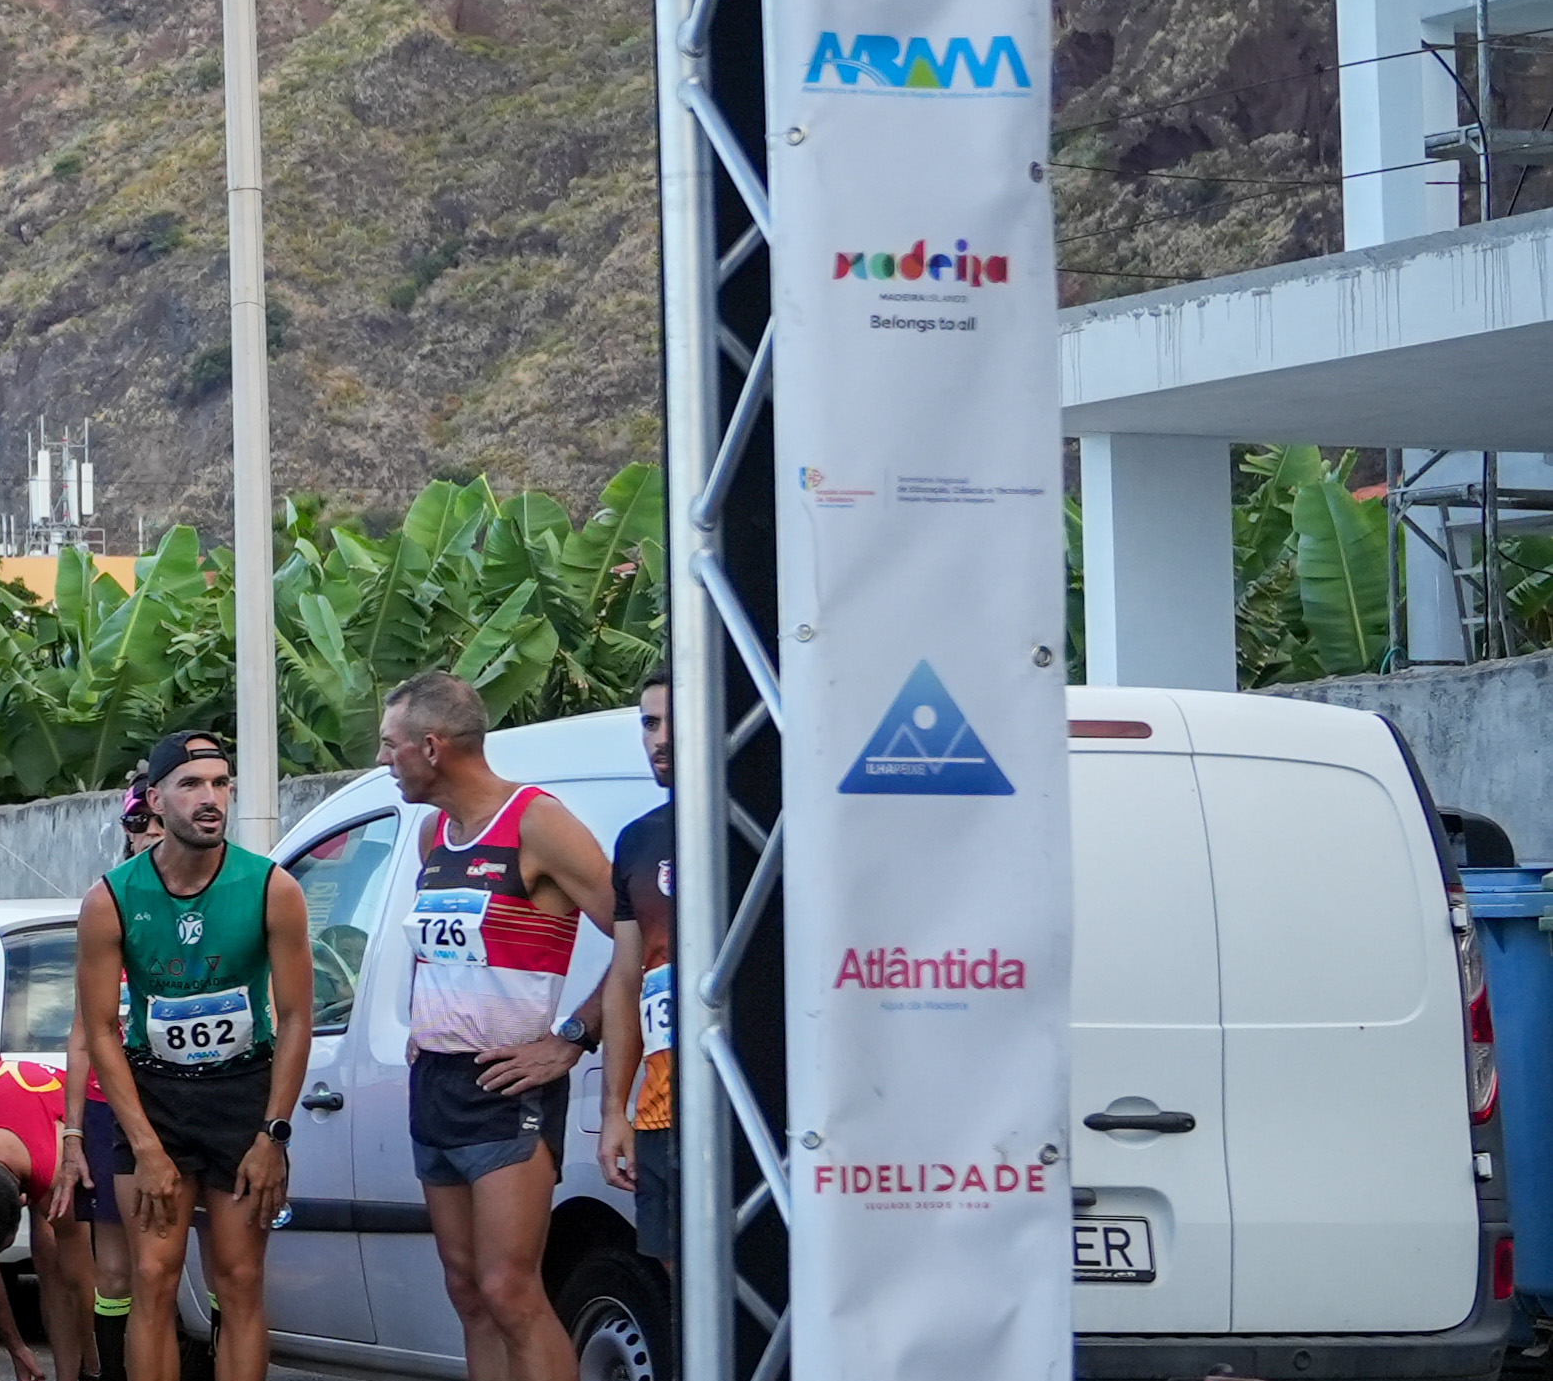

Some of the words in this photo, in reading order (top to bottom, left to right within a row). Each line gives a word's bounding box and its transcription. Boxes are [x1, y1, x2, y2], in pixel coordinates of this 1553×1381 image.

[870, 315, 935, 332] Belongs
[939, 317, 955, 330] to
[959, 317, 976, 330] all
[417, 919, 466, 946] 726
[832, 947, 1026, 989] Atlântida
[167, 1020, 235, 1049] 862
[814, 1164, 1045, 1194] FIDELIDADE
